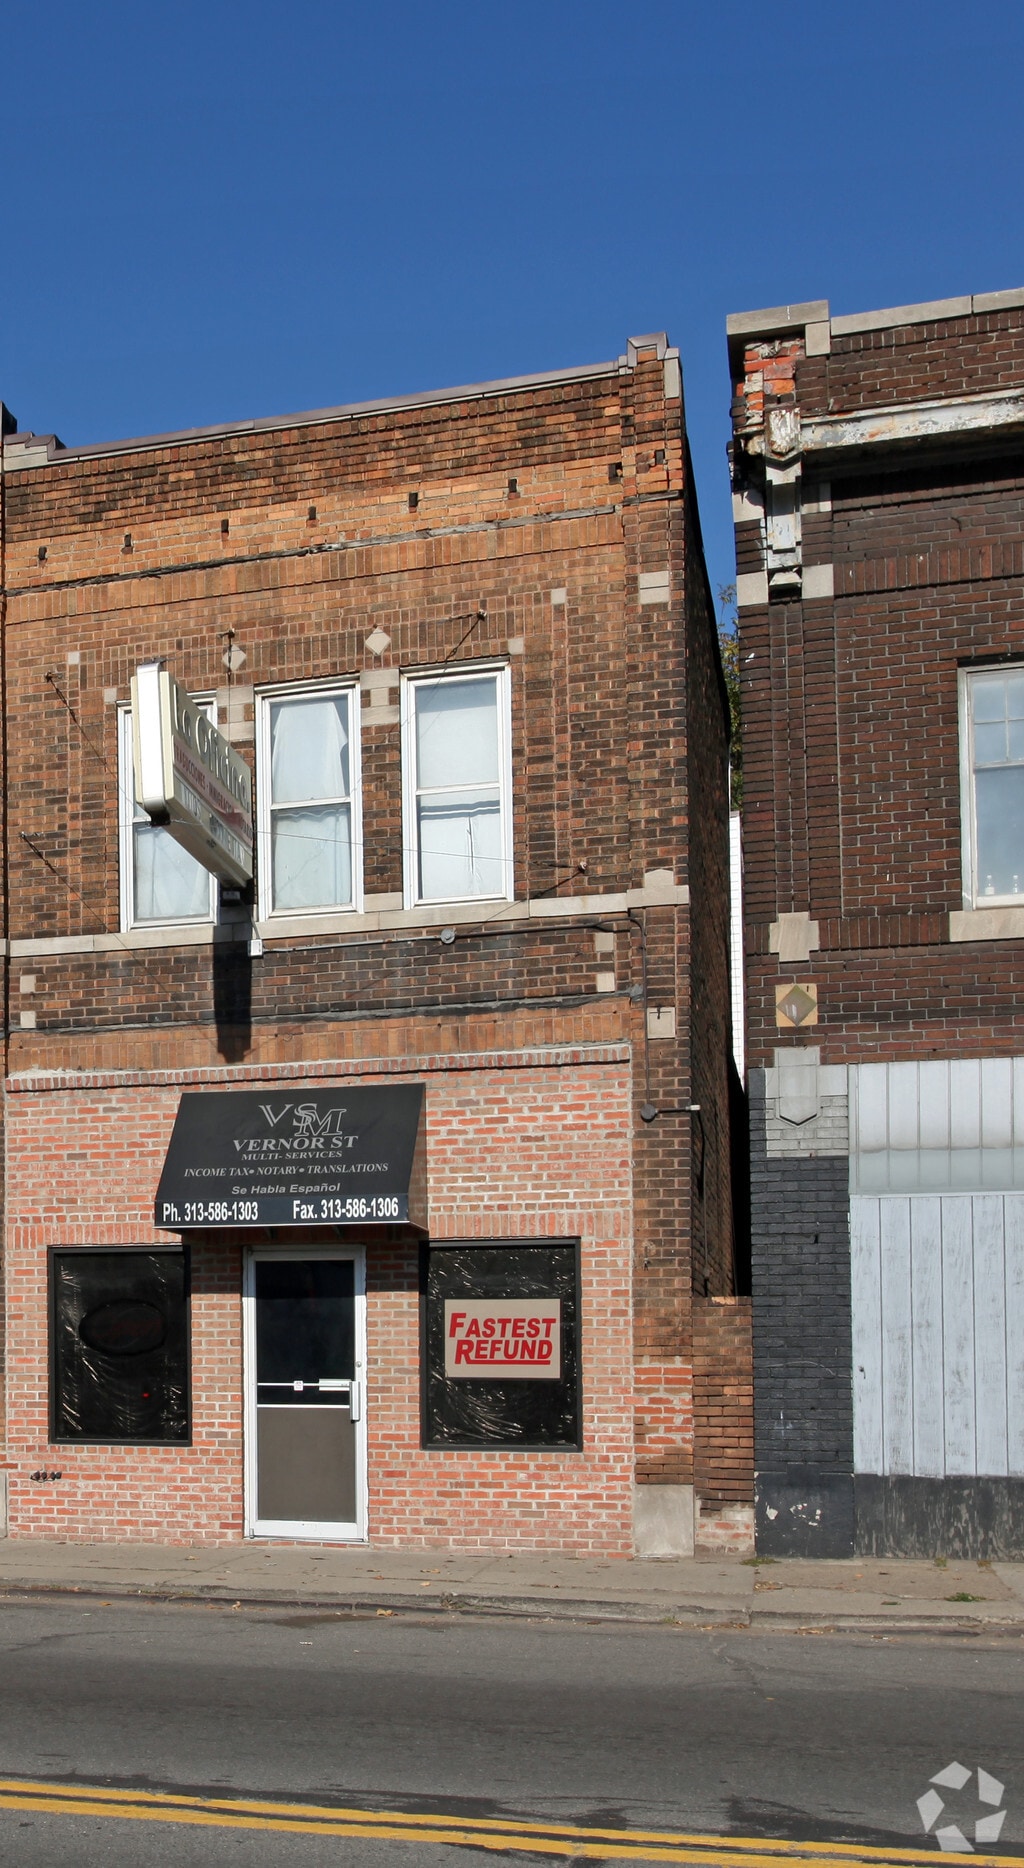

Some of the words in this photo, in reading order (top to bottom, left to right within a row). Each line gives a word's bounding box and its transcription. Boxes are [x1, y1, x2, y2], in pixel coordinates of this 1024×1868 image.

[233, 1137, 325, 1152] VERNOR
[330, 1136, 359, 1149] ST
[285, 1150, 343, 1160] SERVICES
[184, 1167, 227, 1177] INCOME
[256, 1166, 299, 1176] NOTARY
[307, 1163, 389, 1174] TRANSLATIONS
[231, 1186, 248, 1195] Se
[251, 1184, 287, 1194] Habla
[289, 1183, 341, 1194] Español
[163, 1203, 182, 1222] Ph.
[184, 1201, 259, 1221] 313-586-1303
[293, 1199, 318, 1219] Fax.
[320, 1197, 399, 1218] 313-586-1306
[449, 1312, 557, 1338] FASTEST
[454, 1339, 554, 1365] REFUND
